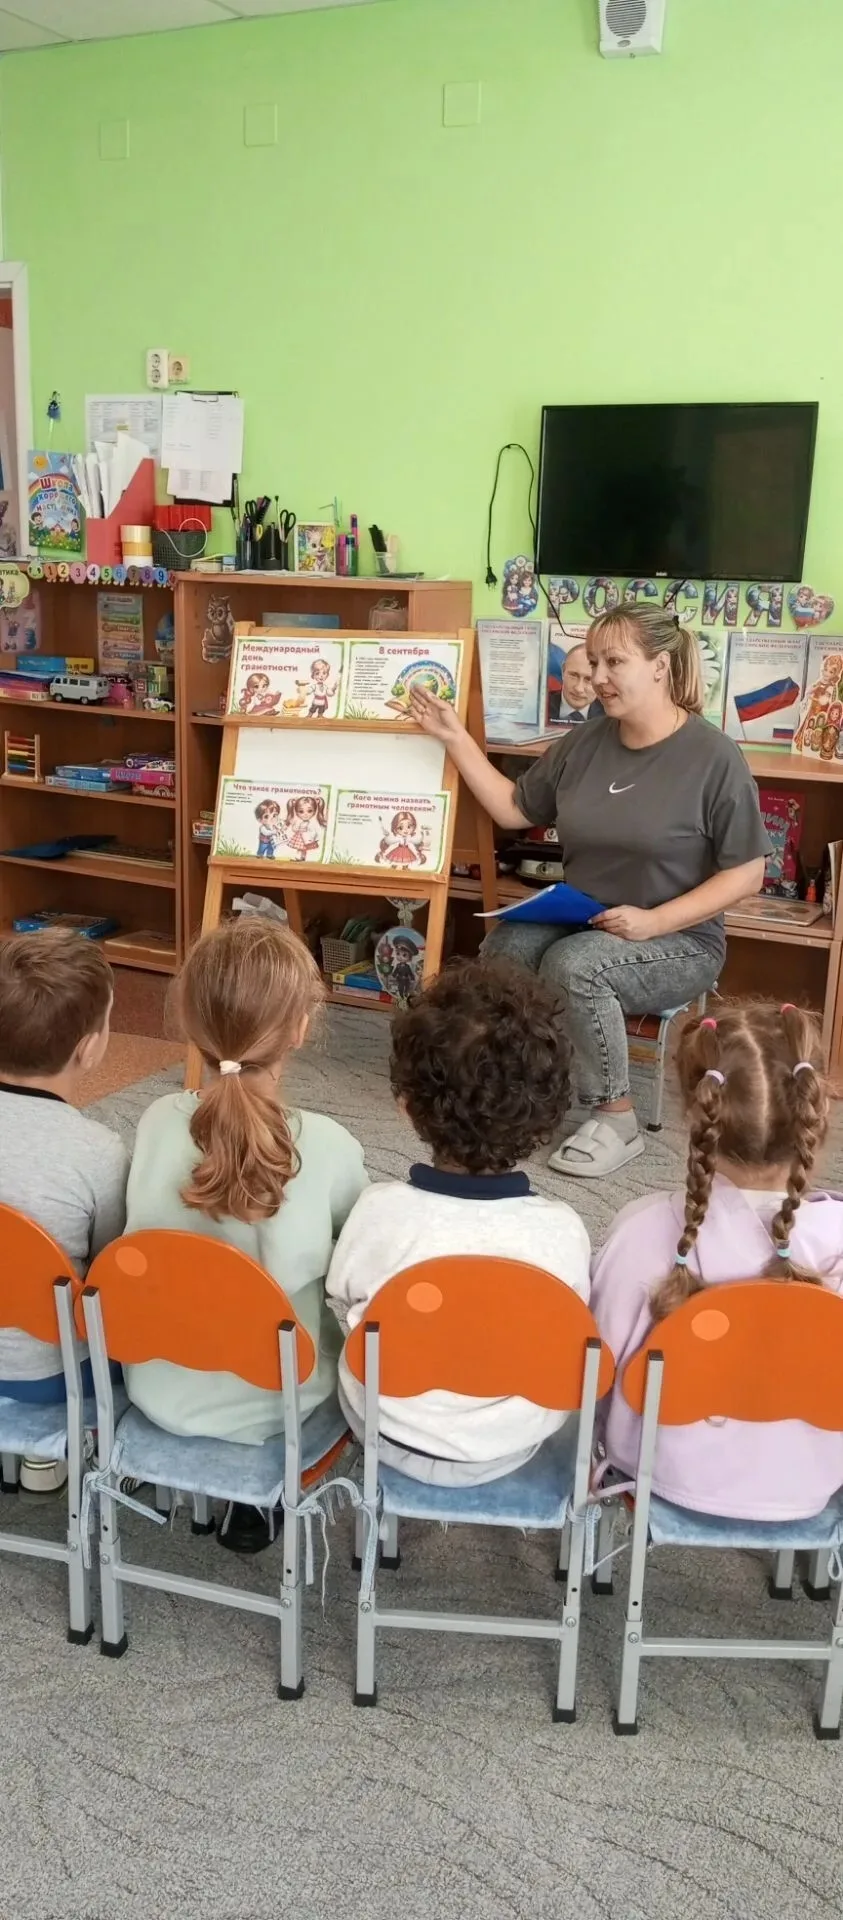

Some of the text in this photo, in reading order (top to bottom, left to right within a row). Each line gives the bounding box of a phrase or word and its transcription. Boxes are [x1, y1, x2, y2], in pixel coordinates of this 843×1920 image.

[60, 565, 66, 574] 2
[75, 568, 81, 578] 3
[90, 568, 96, 577] 4
[158, 571, 164, 581] 9
[547, 576, 784, 628] РОССИЯ
[242, 643, 320, 654] Международный
[378, 646, 430, 656] 8 сентября
[240, 664, 298, 672] грамотности
[233, 783, 322, 796] Что такое грамотность?
[353, 794, 372, 802] Кого
[346, 802, 437, 812] грамотным человеком?
